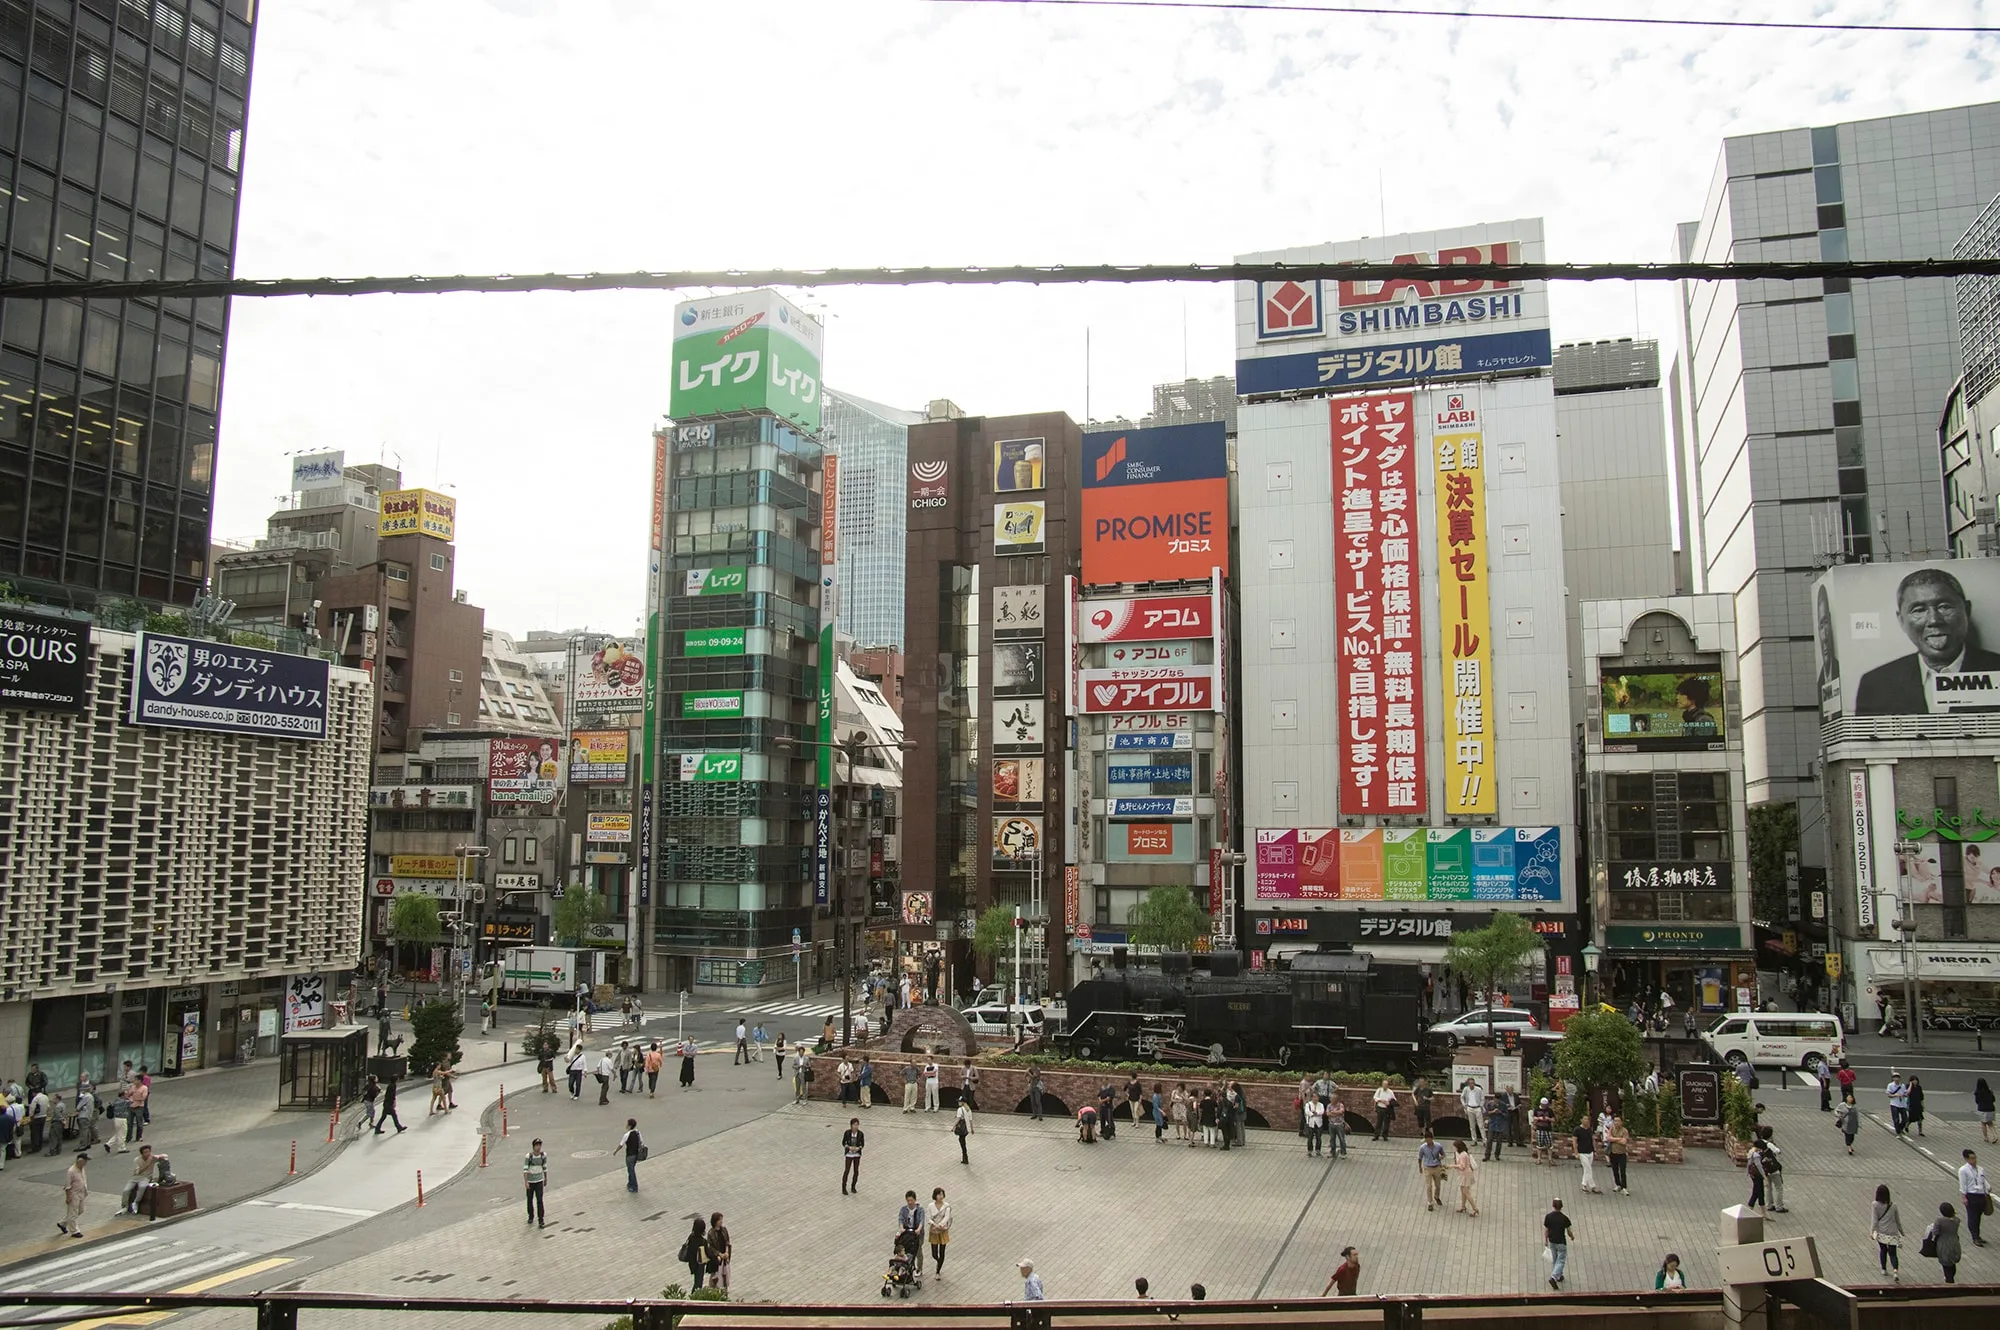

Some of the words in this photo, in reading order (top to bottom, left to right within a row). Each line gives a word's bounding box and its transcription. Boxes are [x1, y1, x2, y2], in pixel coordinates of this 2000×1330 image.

[1338, 241, 1523, 307] LABI
[701, 304, 744, 321] 新生銀行
[1340, 294, 1521, 334] SHIMBASHI
[722, 315, 759, 343] カードローン
[790, 316, 815, 341] 新生銀行
[1318, 344, 1463, 382] デジタル館
[1477, 355, 1537, 367] キムラヤセレクト
[680, 351, 760, 391] レイク
[771, 353, 816, 404] レイク
[1438, 411, 1475, 424] LABI
[679, 425, 710, 441] K-16
[1439, 438, 1478, 472] 全館
[1126, 466, 1161, 474] CONSUMER
[913, 485, 945, 496] 一期一会
[912, 497, 947, 508] ICHIGO
[1096, 512, 1212, 541] PROMISE
[1168, 539, 1211, 554] プロミス
[711, 573, 742, 588] レイク
[1375, 400, 1417, 807] ヤマダは安心価格保証・無料長期保証
[1144, 608, 1200, 629] アコム
[0, 632, 77, 664] OURS
[708, 637, 743, 647] 09-09-24
[1132, 648, 1170, 660] アコム
[1174, 648, 1187, 657] 6F
[192, 648, 274, 676] 男のエステ
[1112, 669, 1184, 679] キャッシングなら
[2, 688, 74, 702] 住友不動産のマンション
[191, 674, 323, 709] ダンディハウス
[647, 678, 655, 711] レイク
[1120, 682, 1204, 706] アイフル
[820, 688, 829, 718] レイク
[147, 702, 234, 722] dandy-house.co.jp
[252, 712, 319, 732] 0120-552-011
[1112, 715, 1161, 728] アイフル
[1166, 715, 1188, 727] 5F
[492, 740, 528, 751] 30歳からの
[1120, 736, 1169, 746] 池野商店
[703, 759, 738, 774] レイク
[491, 790, 552, 803] hana-mail.jp
[1119, 802, 1172, 811] 池野ビルメンテナンス
[818, 809, 829, 859] かんべ土地
[1259, 831, 1276, 842] B1F
[1303, 832, 1313, 841] 1F
[1343, 831, 1356, 841] 2F
[1386, 831, 1399, 841] 3F
[1429, 831, 1442, 841] 4F
[1475, 831, 1487, 841] 5F
[1518, 830, 1531, 841] 6F
[1133, 837, 1168, 848] プロミス
[397, 860, 464, 870] リーチ麻雀のリー
[1623, 866, 1717, 887] 椿屋珈琲店
[1272, 919, 1308, 930] LABI
[1360, 918, 1453, 937] デジタル館
[1928, 956, 1991, 964] HIROTA
